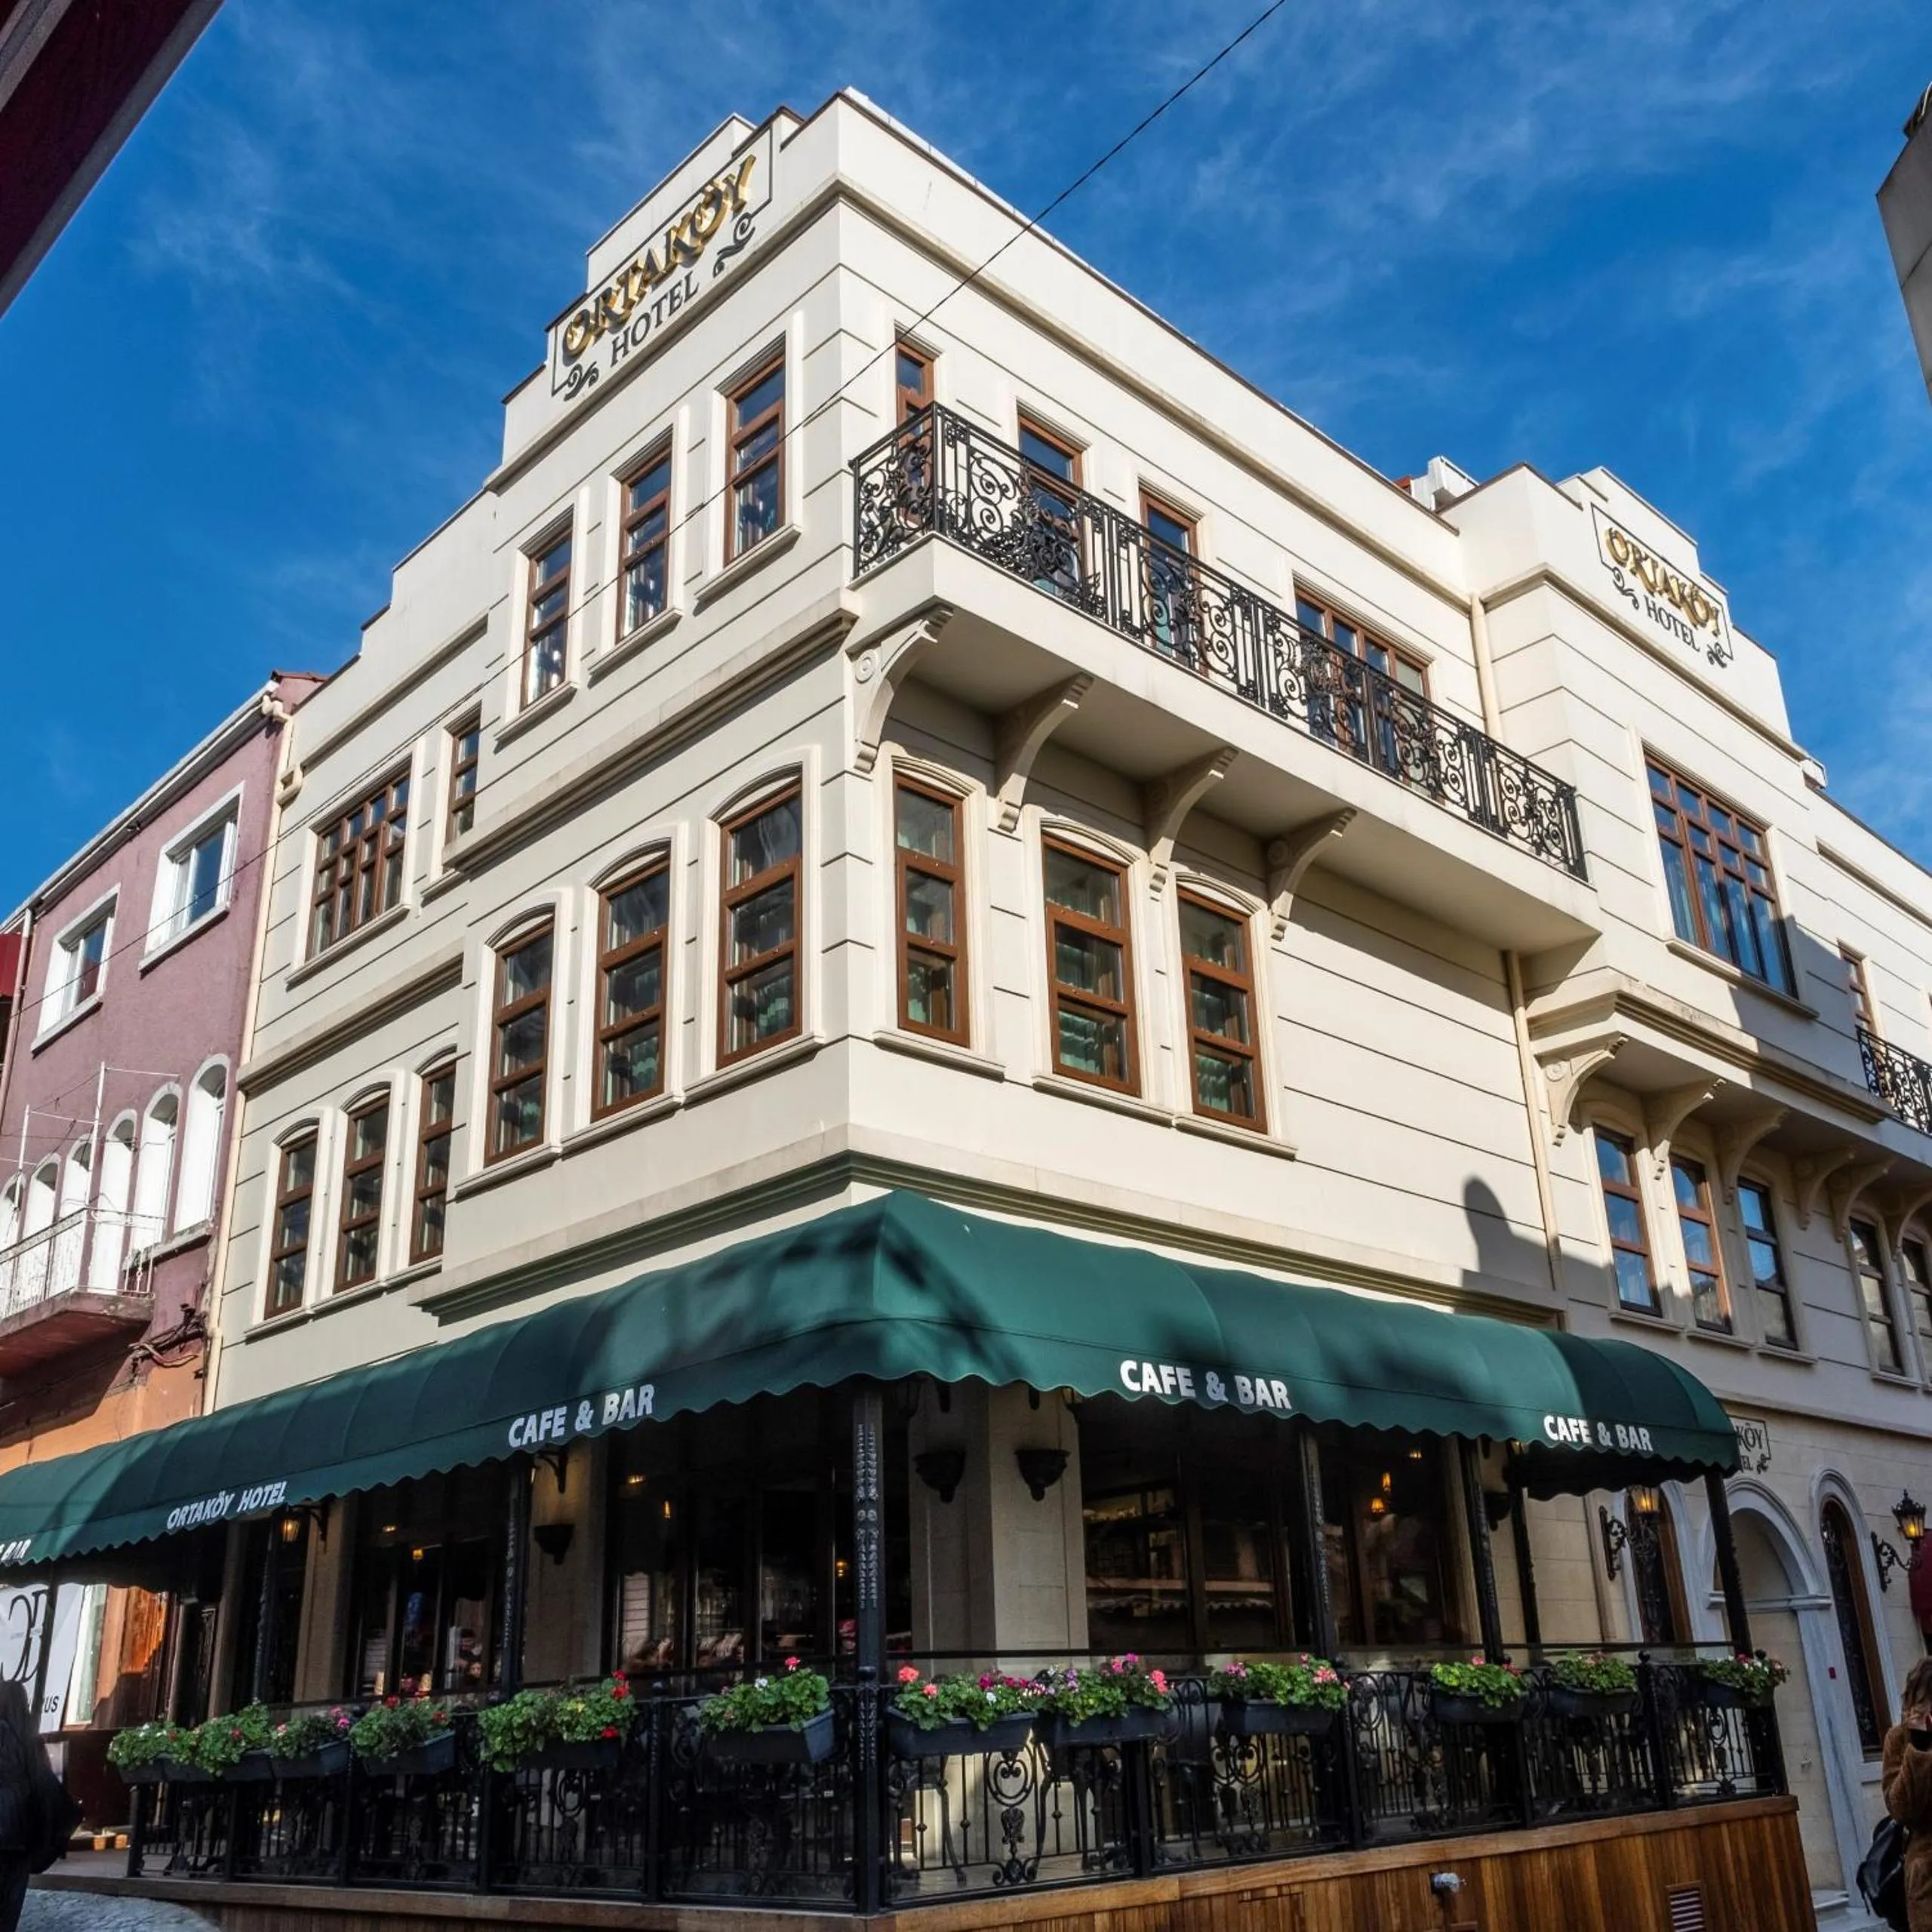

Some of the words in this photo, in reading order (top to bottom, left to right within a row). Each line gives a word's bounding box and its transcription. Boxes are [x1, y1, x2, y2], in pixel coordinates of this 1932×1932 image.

[562, 154, 757, 365] ORTAKÖY
[610, 270, 700, 368] HOTEL
[1643, 594, 1701, 652] HOTEL
[1120, 1359, 1196, 1398] CAFE
[1205, 1371, 1229, 1402] &
[1235, 1374, 1293, 1411] BAR
[508, 1406, 568, 1448] CAFE
[574, 1399, 594, 1432] &
[601, 1383, 655, 1426] BAR
[1543, 1414, 1592, 1444] CAFE
[1596, 1421, 1614, 1447] &
[1615, 1423, 1654, 1452] BAR
[166, 1490, 235, 1530] ORTAKÖY
[236, 1481, 288, 1512] HOTEL
